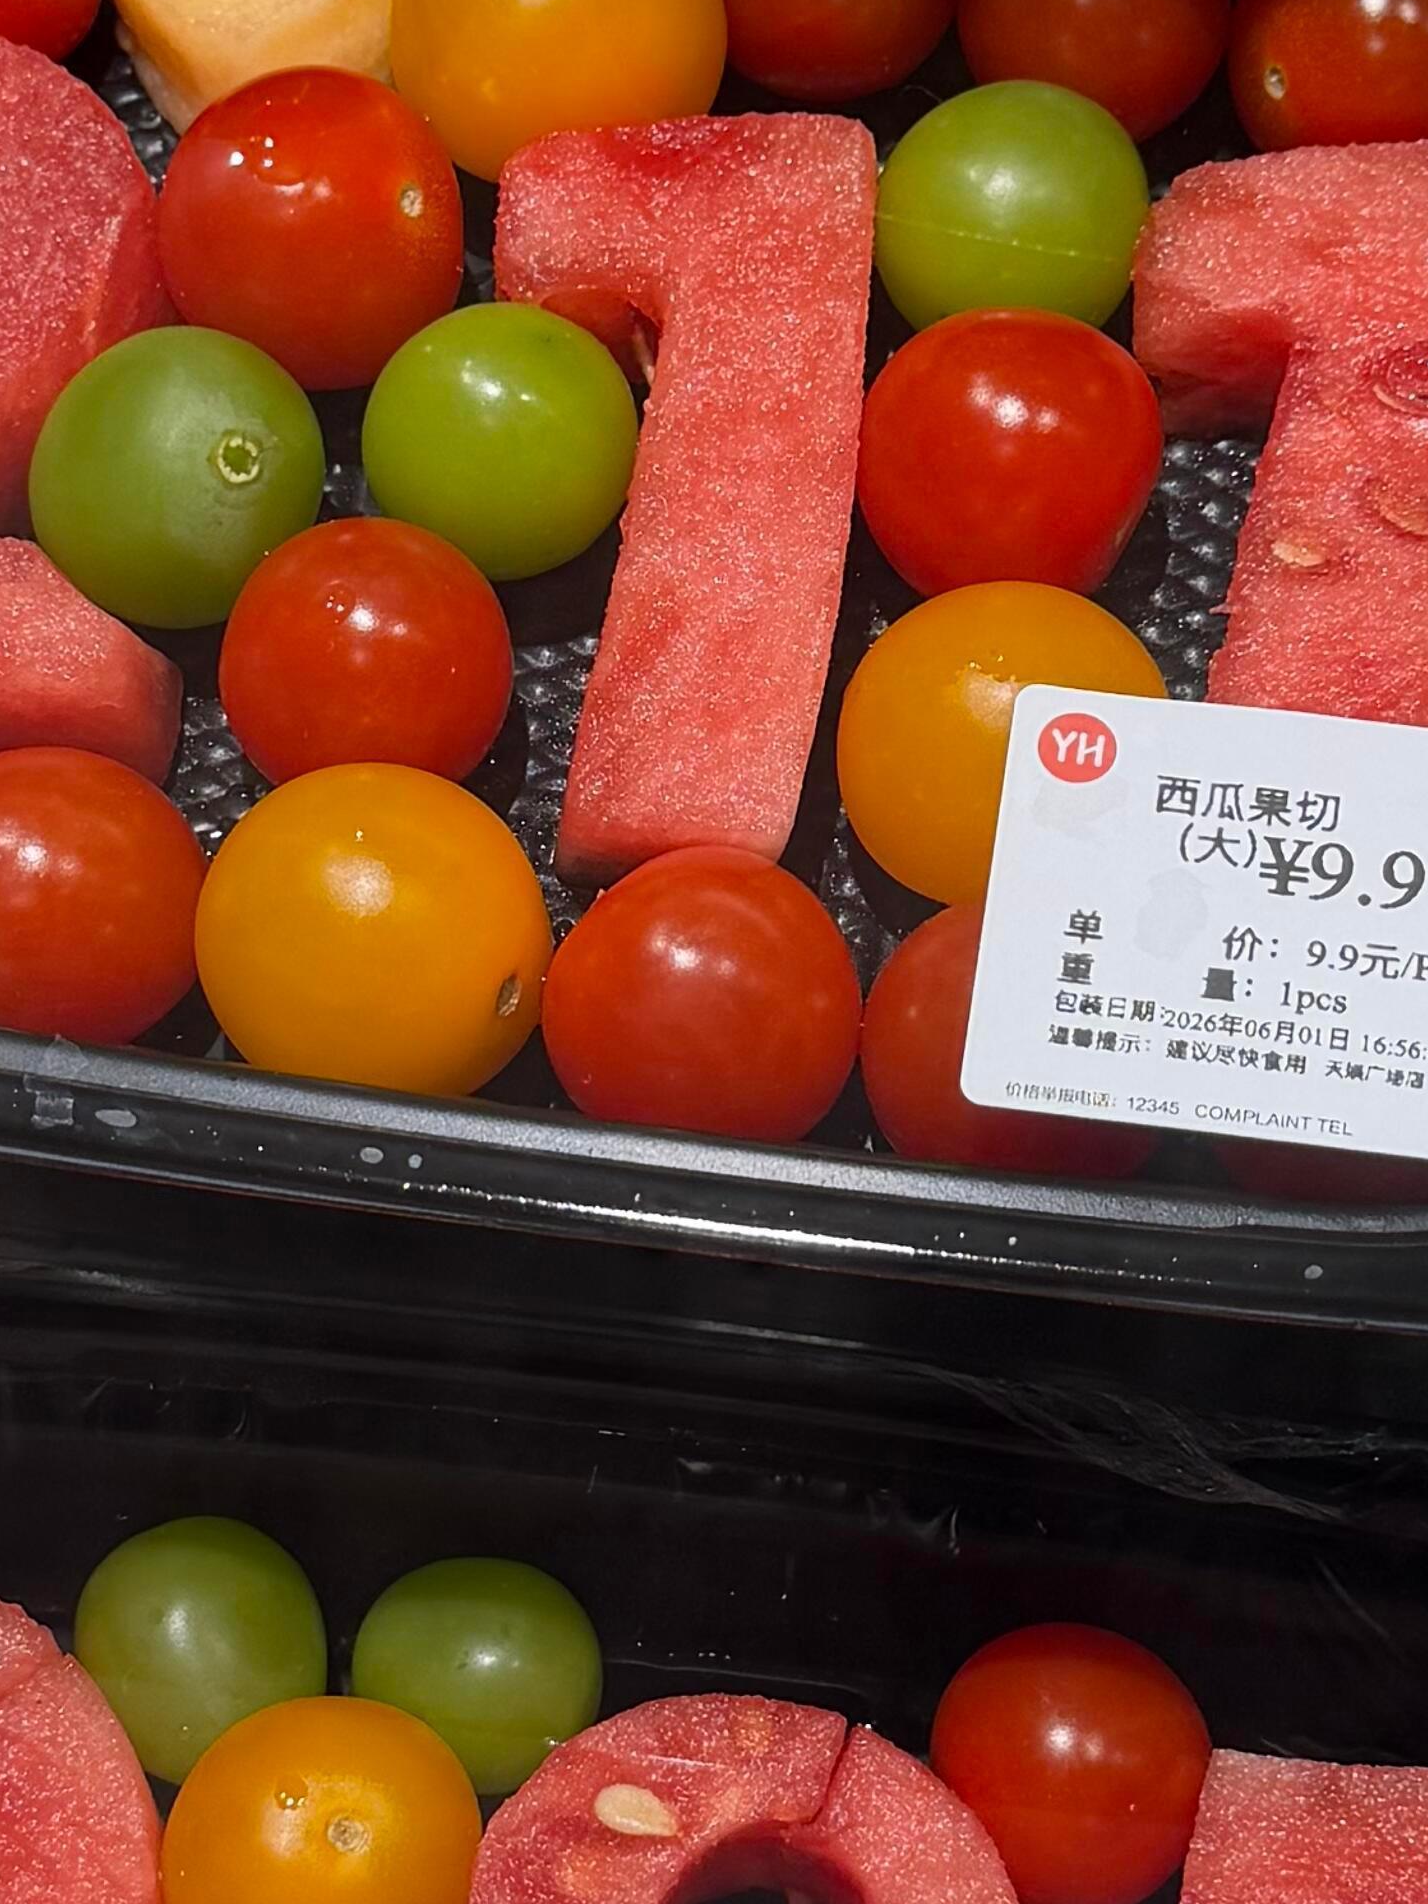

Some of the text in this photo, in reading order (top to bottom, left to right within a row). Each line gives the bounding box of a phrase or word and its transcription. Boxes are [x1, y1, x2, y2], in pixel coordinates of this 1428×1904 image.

[1051, 727, 1106, 769] YH
[1155, 774, 1342, 833] 西瓜果切
[1258, 834, 1427, 910] ¥9.9
[1063, 909, 1104, 945] 单
[1057, 952, 1095, 986] 重
[1280, 981, 1348, 1015] 1pcs
[1126, 1096, 1180, 1115] 12345
[1194, 1103, 1314, 1132] COMPLAINT
[1316, 1117, 1354, 1137] TEL
